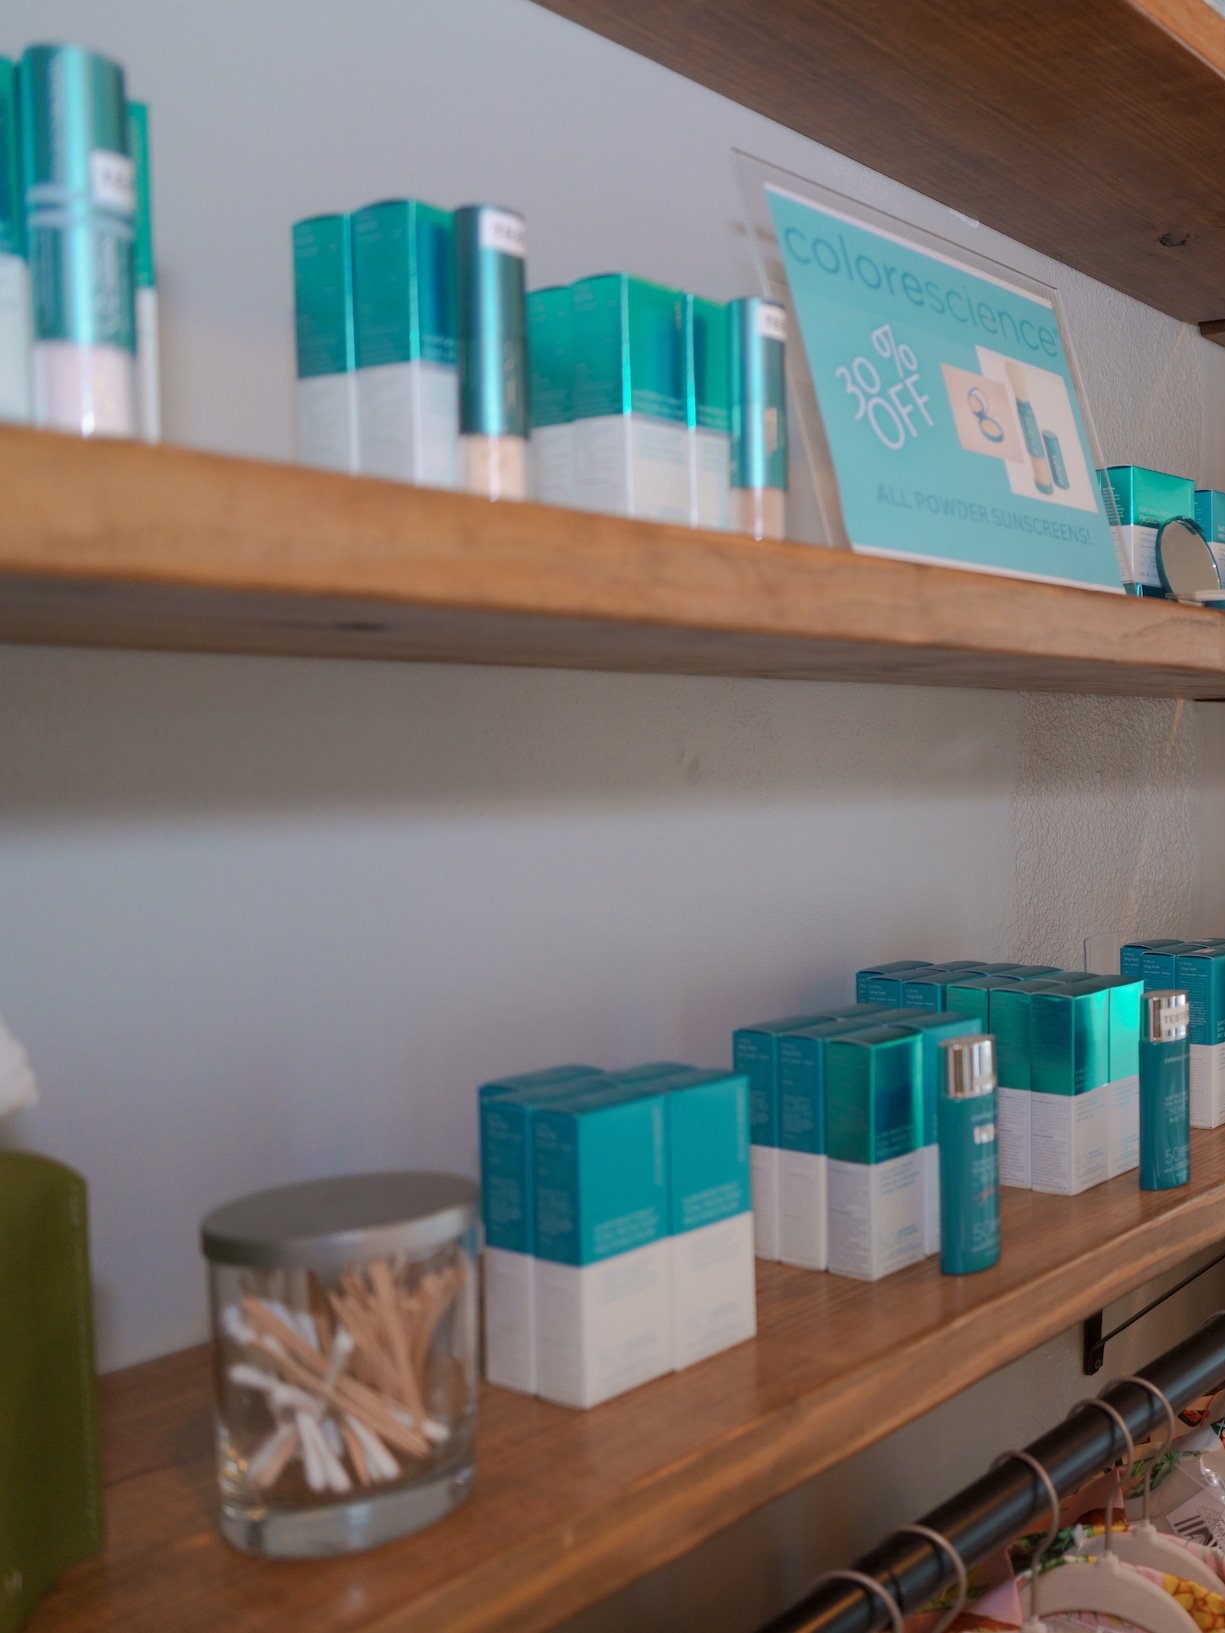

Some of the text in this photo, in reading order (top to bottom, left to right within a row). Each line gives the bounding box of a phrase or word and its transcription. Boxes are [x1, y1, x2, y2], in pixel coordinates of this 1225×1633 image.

[784, 225, 1059, 359] colorescience
[867, 374, 934, 450] OFF
[877, 484, 1092, 546] ALL POWDER SUNSCREENS!
